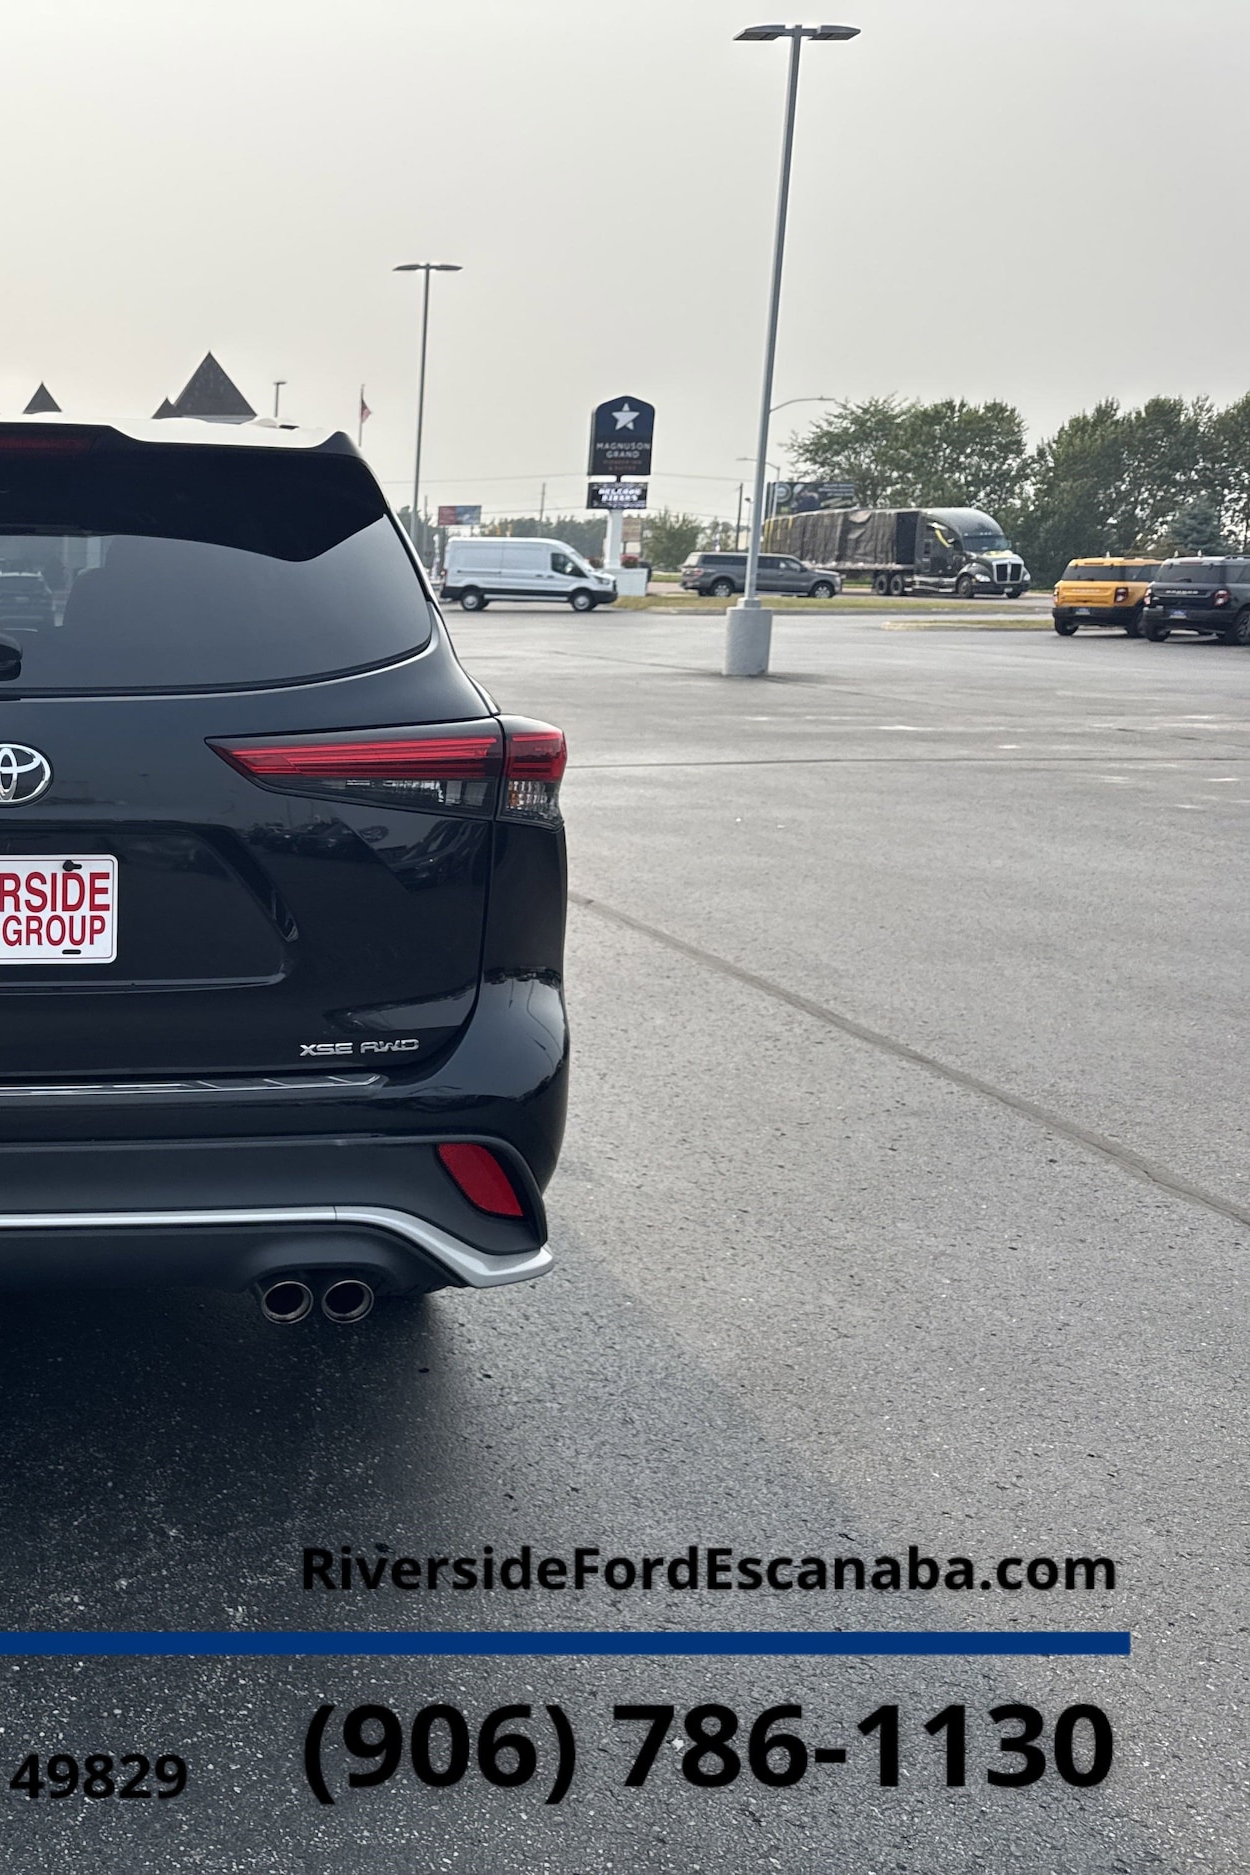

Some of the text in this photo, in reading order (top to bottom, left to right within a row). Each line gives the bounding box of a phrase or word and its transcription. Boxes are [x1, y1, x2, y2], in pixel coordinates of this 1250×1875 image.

[596, 442, 651, 451] MAGNUSON
[605, 450, 641, 459] GRAND
[2, 914, 107, 947] GROUP
[299, 1038, 420, 1057] XSE AWD
